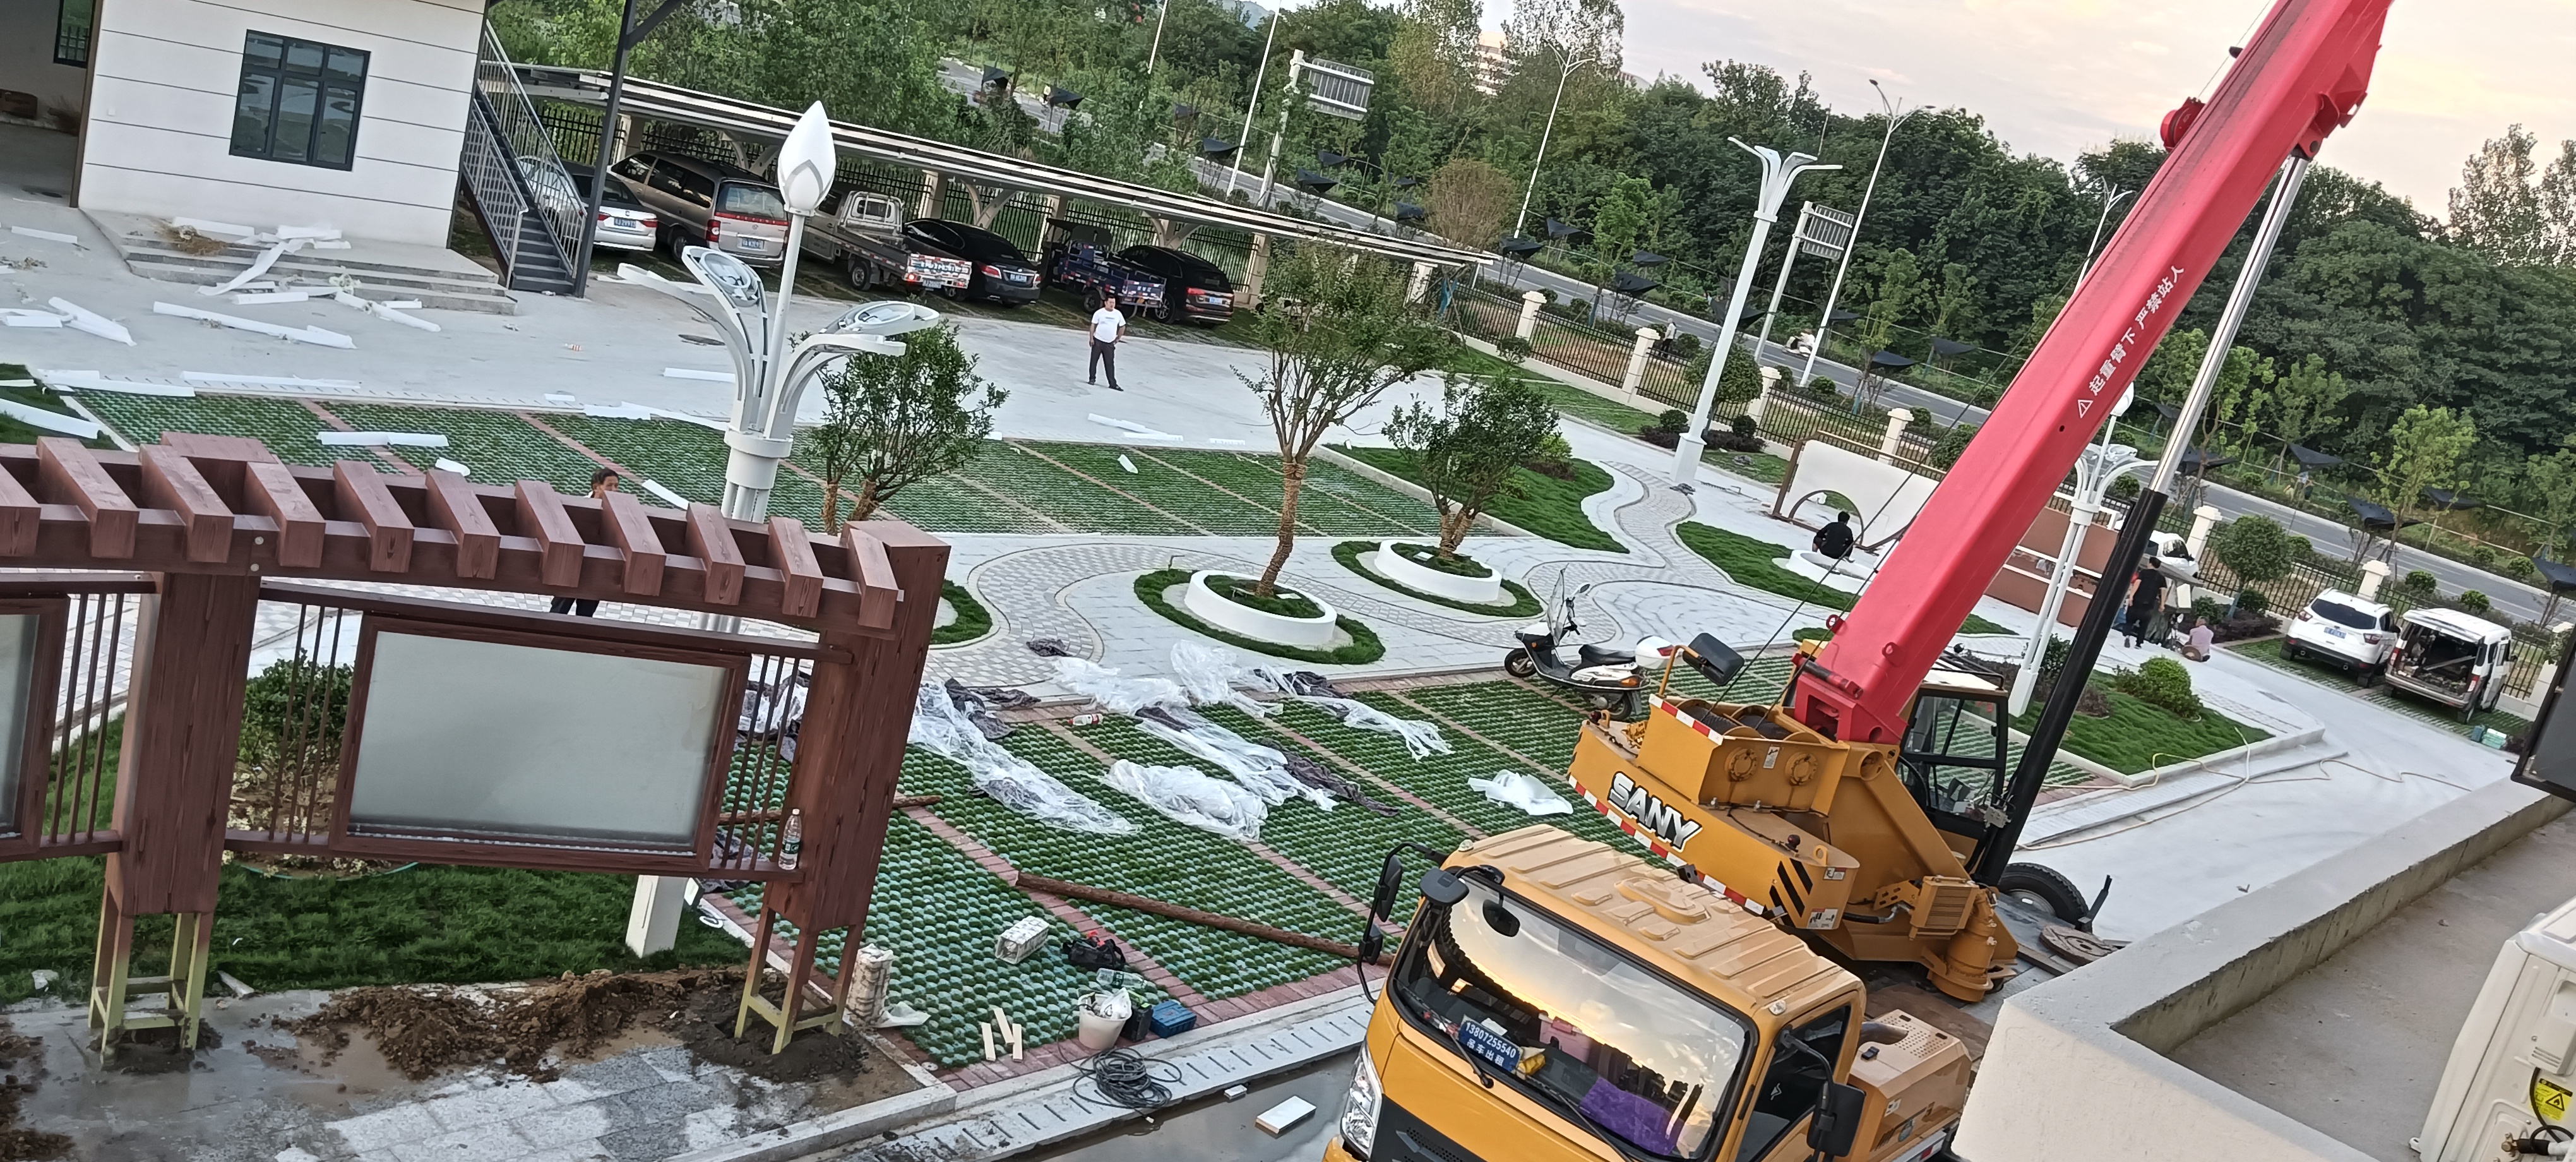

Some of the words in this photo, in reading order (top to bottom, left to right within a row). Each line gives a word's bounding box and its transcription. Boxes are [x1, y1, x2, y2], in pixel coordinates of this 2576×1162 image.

[1608, 772, 1701, 849] SANY
[1465, 1022, 1517, 1058] 13807255540
[1466, 1038, 1505, 1067] 吊车出租
